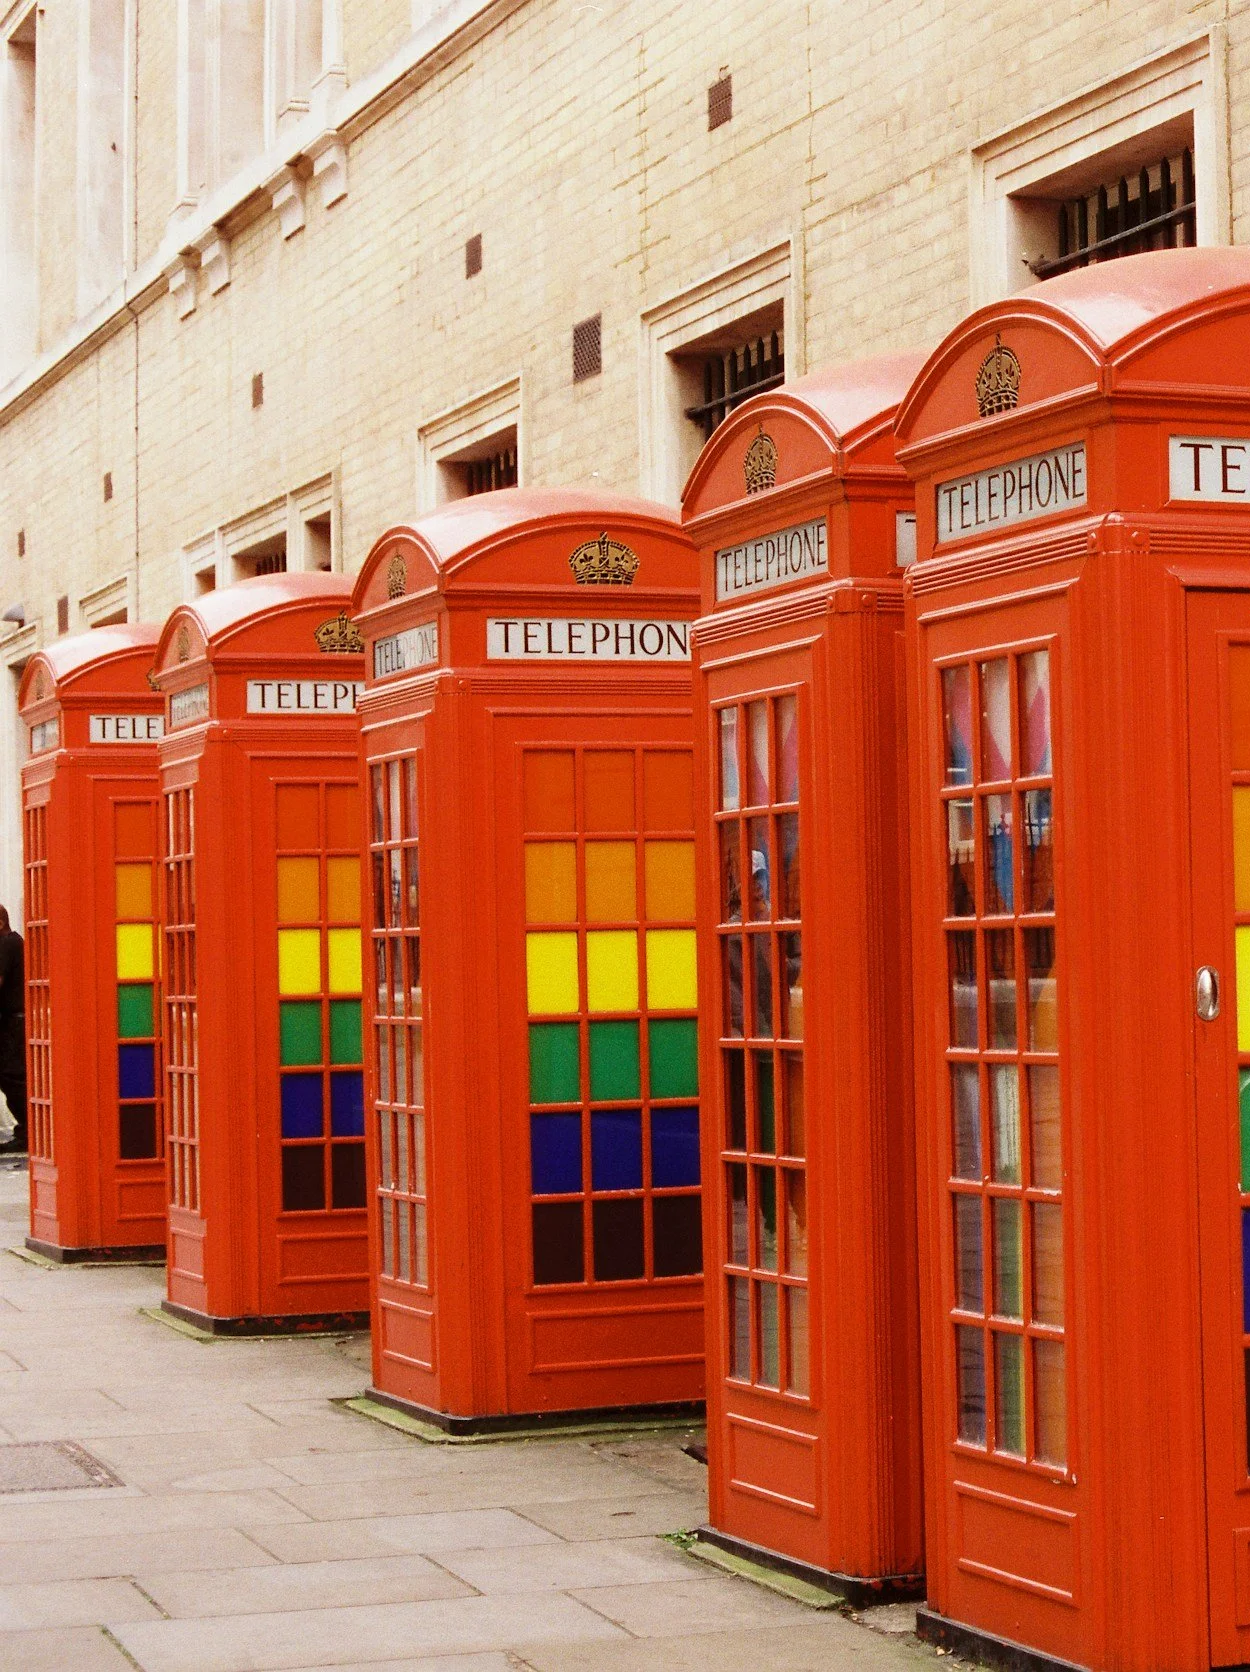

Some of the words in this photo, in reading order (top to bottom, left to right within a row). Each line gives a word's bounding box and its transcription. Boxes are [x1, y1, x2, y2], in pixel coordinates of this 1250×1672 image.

[943, 449, 1084, 532] TELEPHONE
[721, 523, 827, 592] TELEPHONE
[494, 621, 688, 655] TELEPHON
[95, 717, 166, 739] TELE
